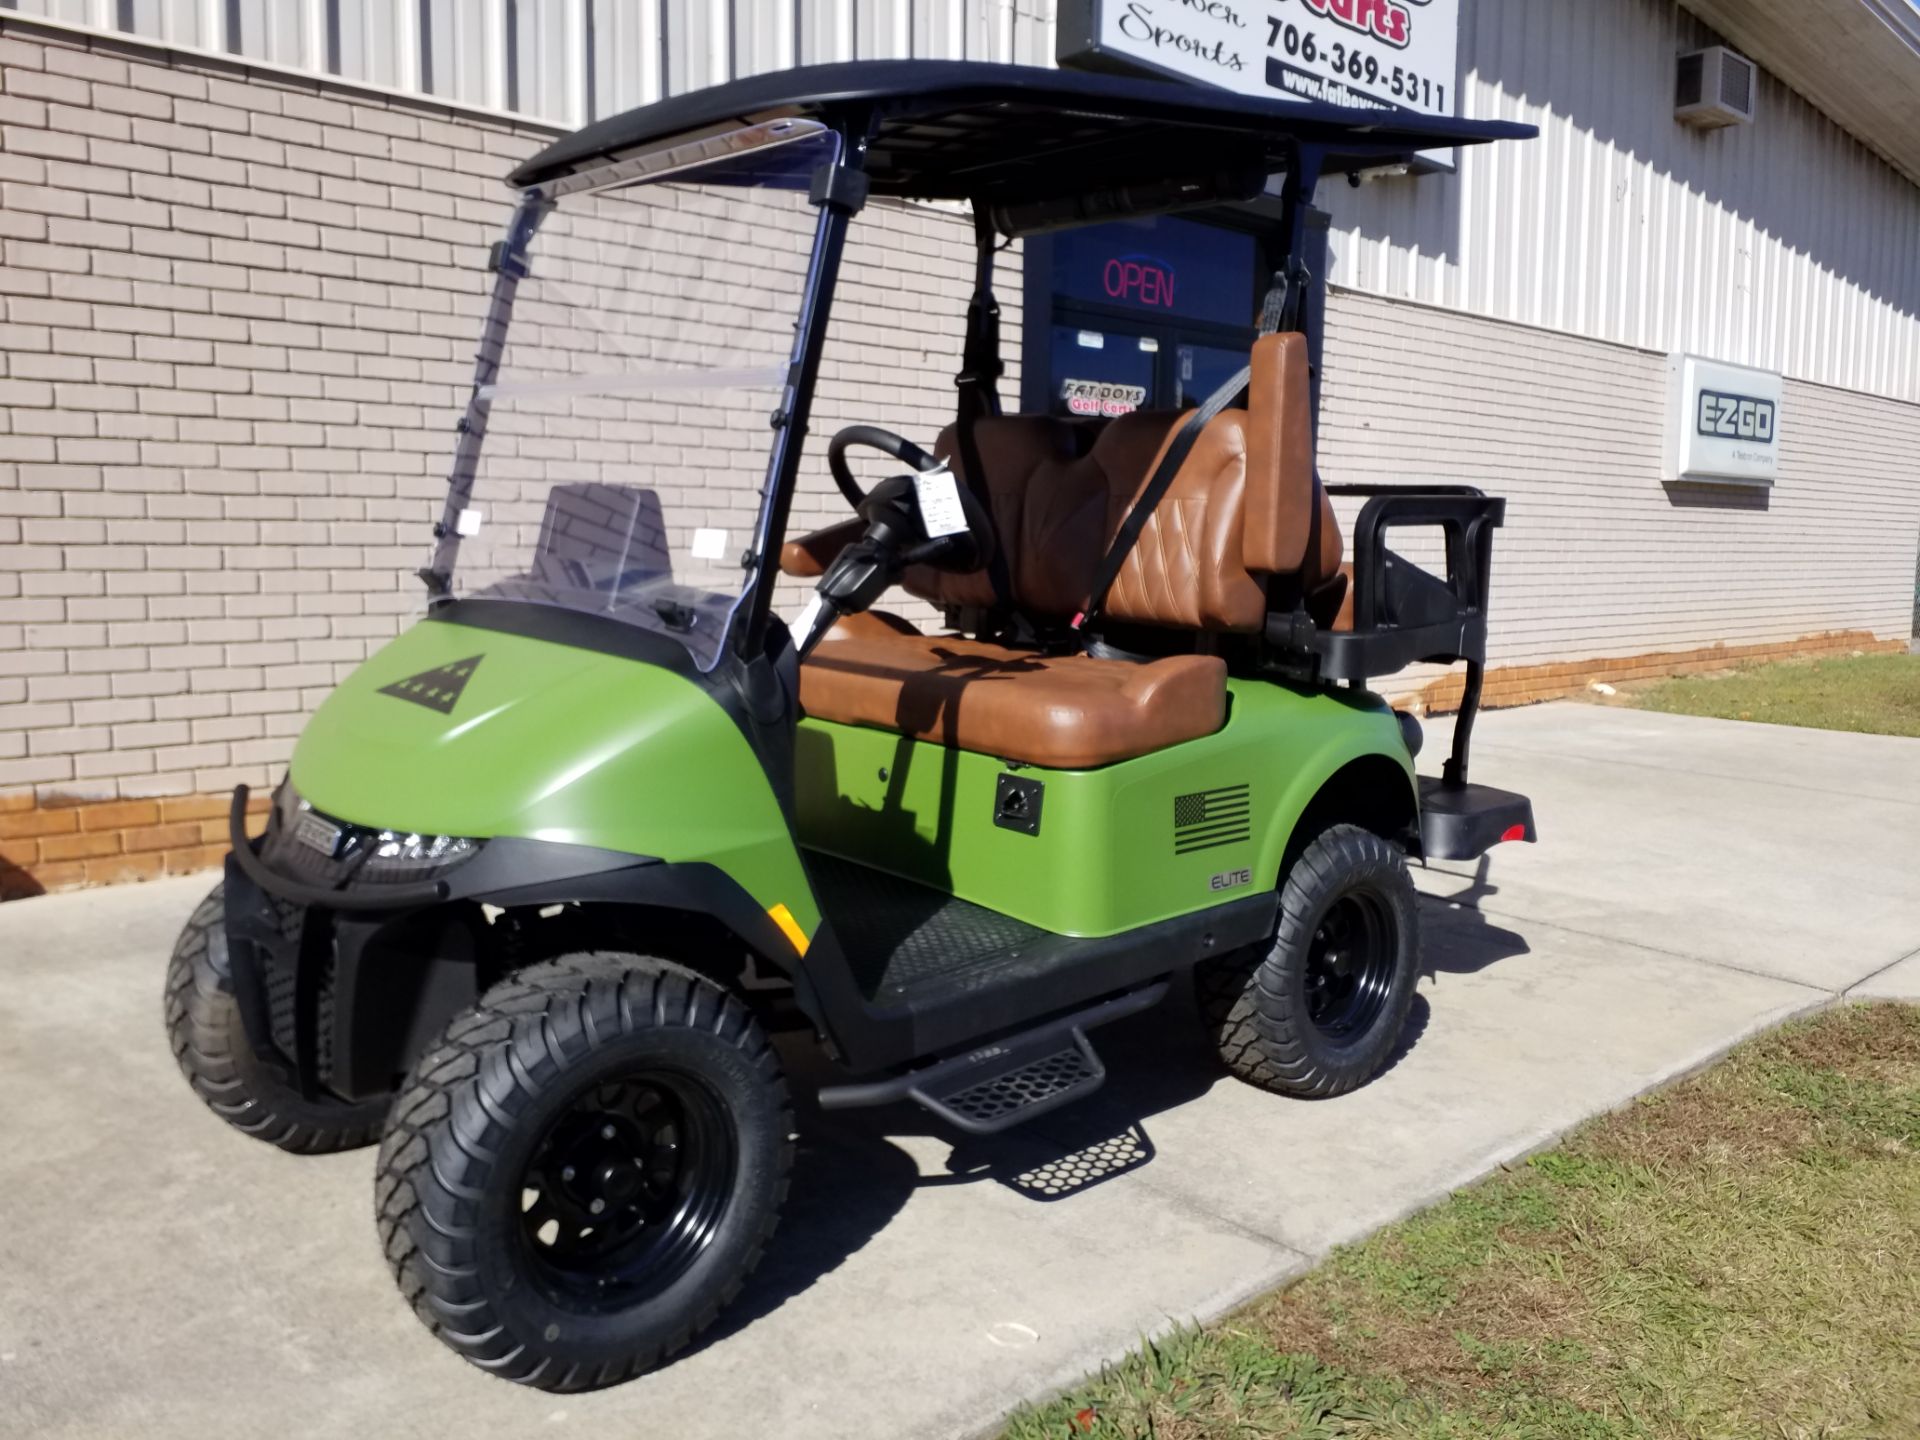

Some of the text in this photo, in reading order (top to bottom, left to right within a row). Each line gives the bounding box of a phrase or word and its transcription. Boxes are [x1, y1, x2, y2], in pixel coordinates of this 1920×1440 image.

[1118, 2, 1247, 71] Sports
[1308, 0, 1406, 43] arts
[1267, 15, 1444, 113] 706-369-5311
[1103, 259, 1174, 307] OPEN
[1699, 392, 1773, 440] EZGO
[1211, 869, 1249, 889] ELITE
